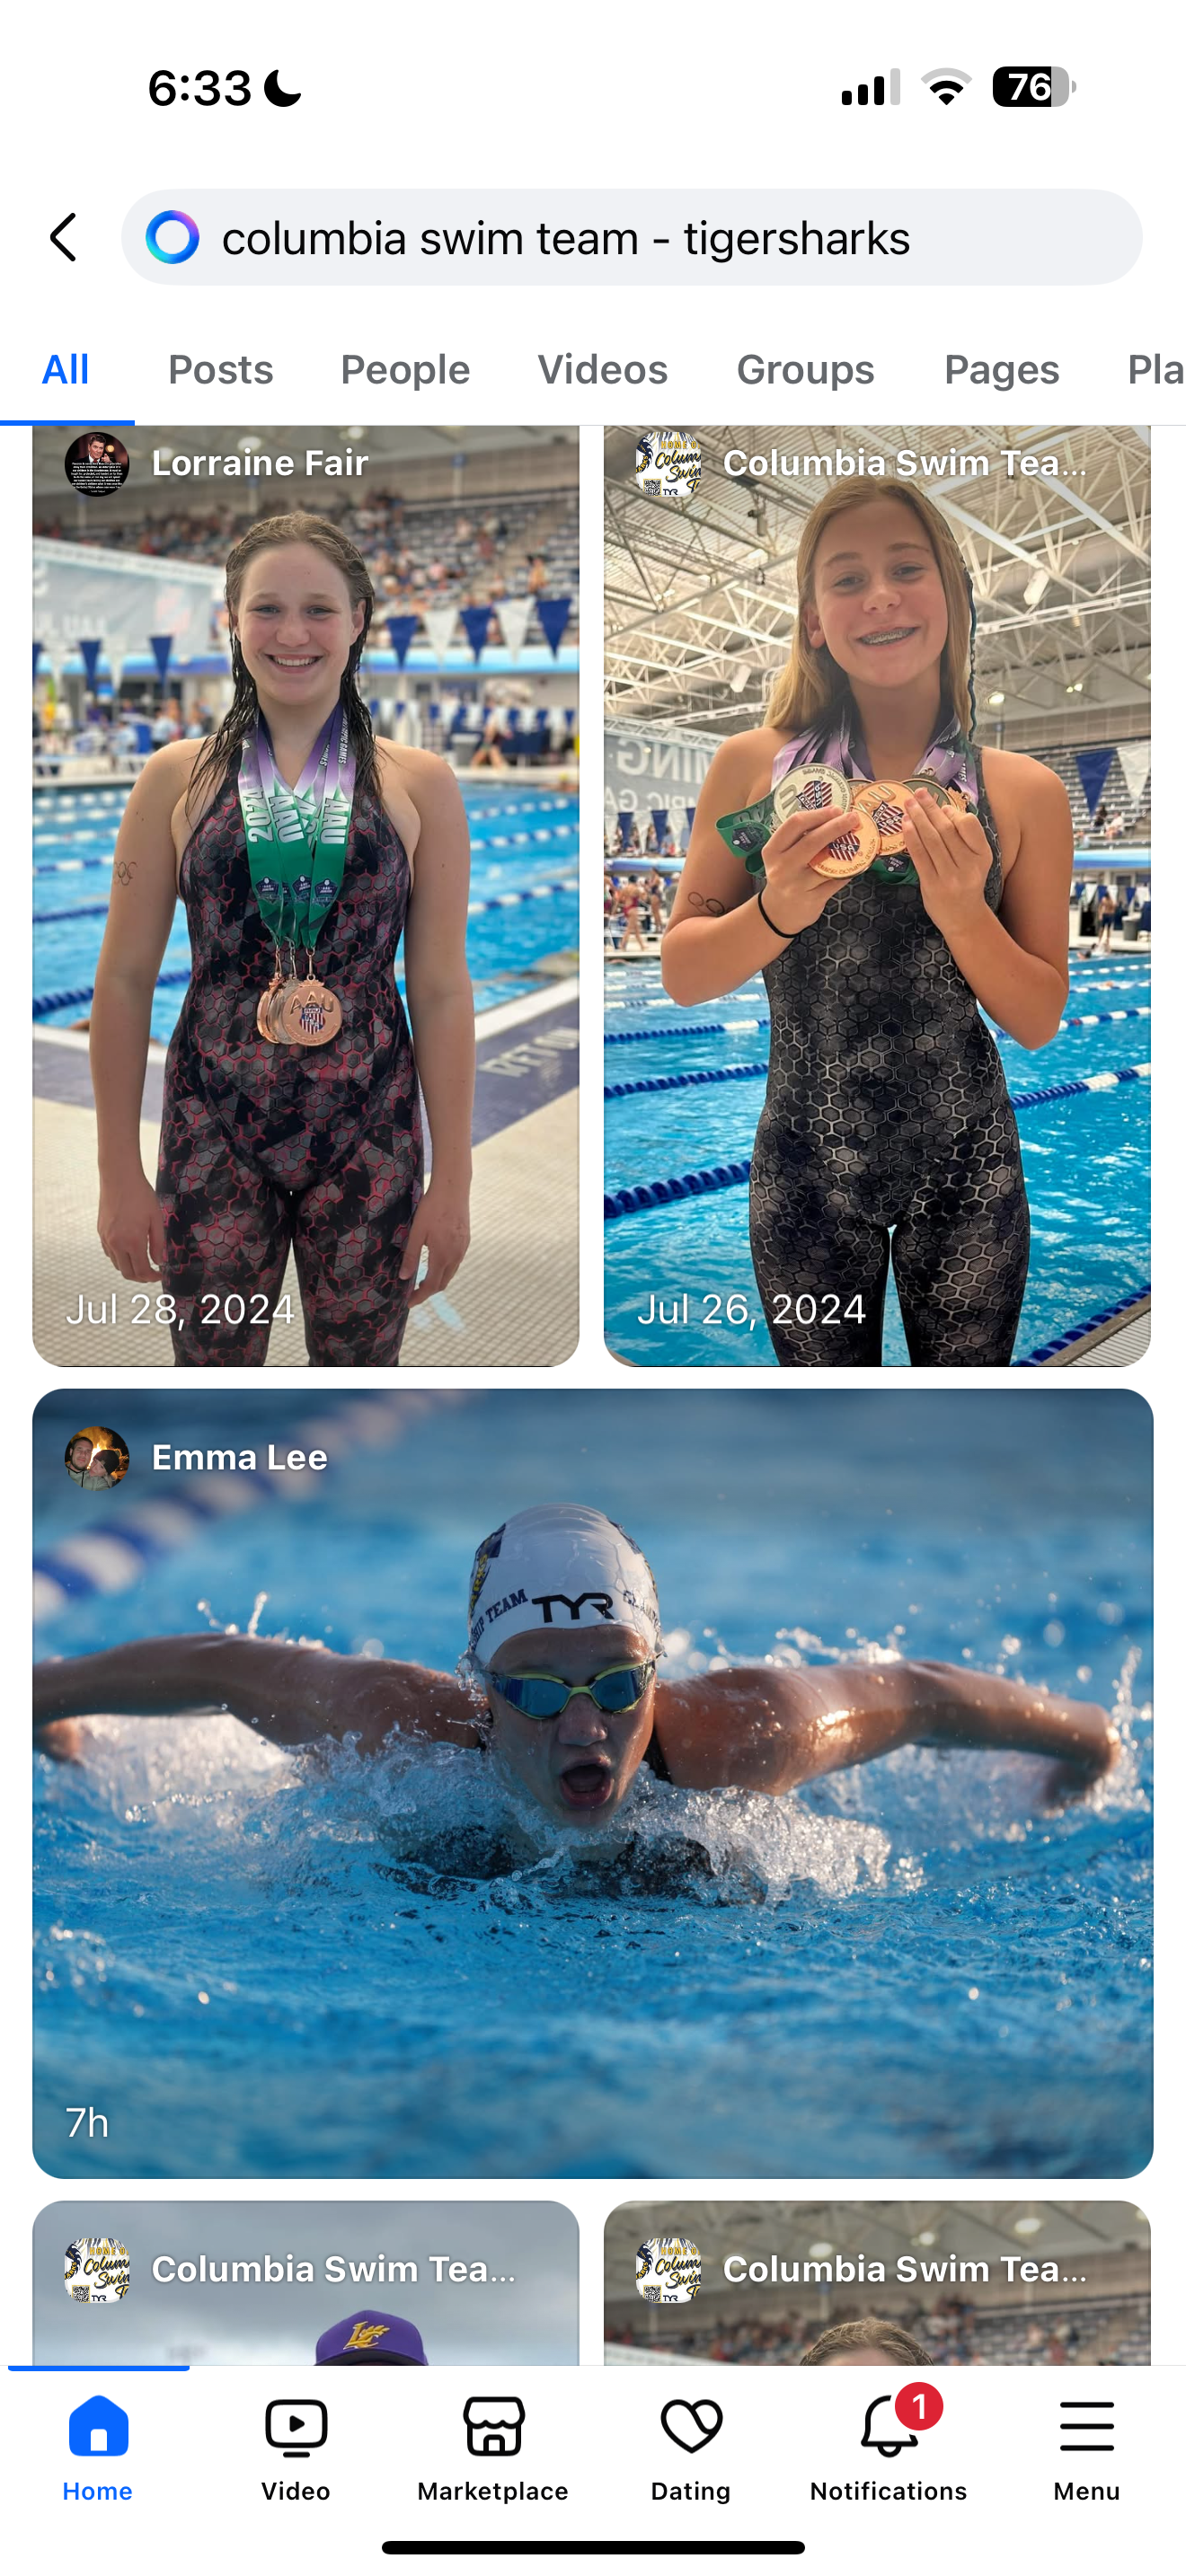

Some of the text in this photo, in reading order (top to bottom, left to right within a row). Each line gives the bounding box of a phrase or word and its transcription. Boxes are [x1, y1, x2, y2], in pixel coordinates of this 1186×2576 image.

[148, 69, 252, 107] 6:33
[1008, 72, 1052, 101] 76
[222, 219, 405, 256] columbia
[420, 219, 524, 256] swim
[535, 223, 639, 256] team
[683, 219, 910, 264] tigersharks
[41, 353, 89, 384] All
[170, 354, 274, 384] Posts
[342, 353, 470, 392] People
[537, 352, 668, 384] Videos
[738, 354, 875, 392] Groups
[946, 354, 1060, 392] Pages
[1128, 353, 1185, 384] Pla
[153, 447, 370, 476] Lorraine Fair
[655, 449, 702, 470] Colum
[723, 446, 886, 477] Columbia
[897, 446, 989, 477] Swim
[813, 783, 823, 807] USA
[268, 793, 305, 844] AAU
[319, 797, 350, 845] AAU
[832, 842, 856, 852] USA
[289, 991, 335, 1019] AAU
[65, 1293, 296, 1332] Jul 28, 2024
[637, 1293, 867, 1332] Jul 26, 2024
[153, 1444, 328, 1471] Emma Lee
[484, 1588, 529, 1624] TEAM
[531, 1592, 615, 1624] TYR
[65, 2105, 109, 2138] 7h
[84, 2255, 130, 2276] Colum
[151, 2253, 314, 2284] Columbia
[324, 2253, 419, 2284] Swim
[655, 2255, 702, 2276] Colum
[722, 2253, 886, 2283] Columbia
[897, 2253, 990, 2283] Swim
[912, 2395, 926, 2420] 1
[63, 2482, 134, 2501] Home
[261, 2480, 331, 2501] Video
[418, 2481, 569, 2506] Marketplace
[651, 2480, 730, 2506] Dating
[810, 2480, 967, 2501] Notifications
[1054, 2482, 1120, 2501] Menu
